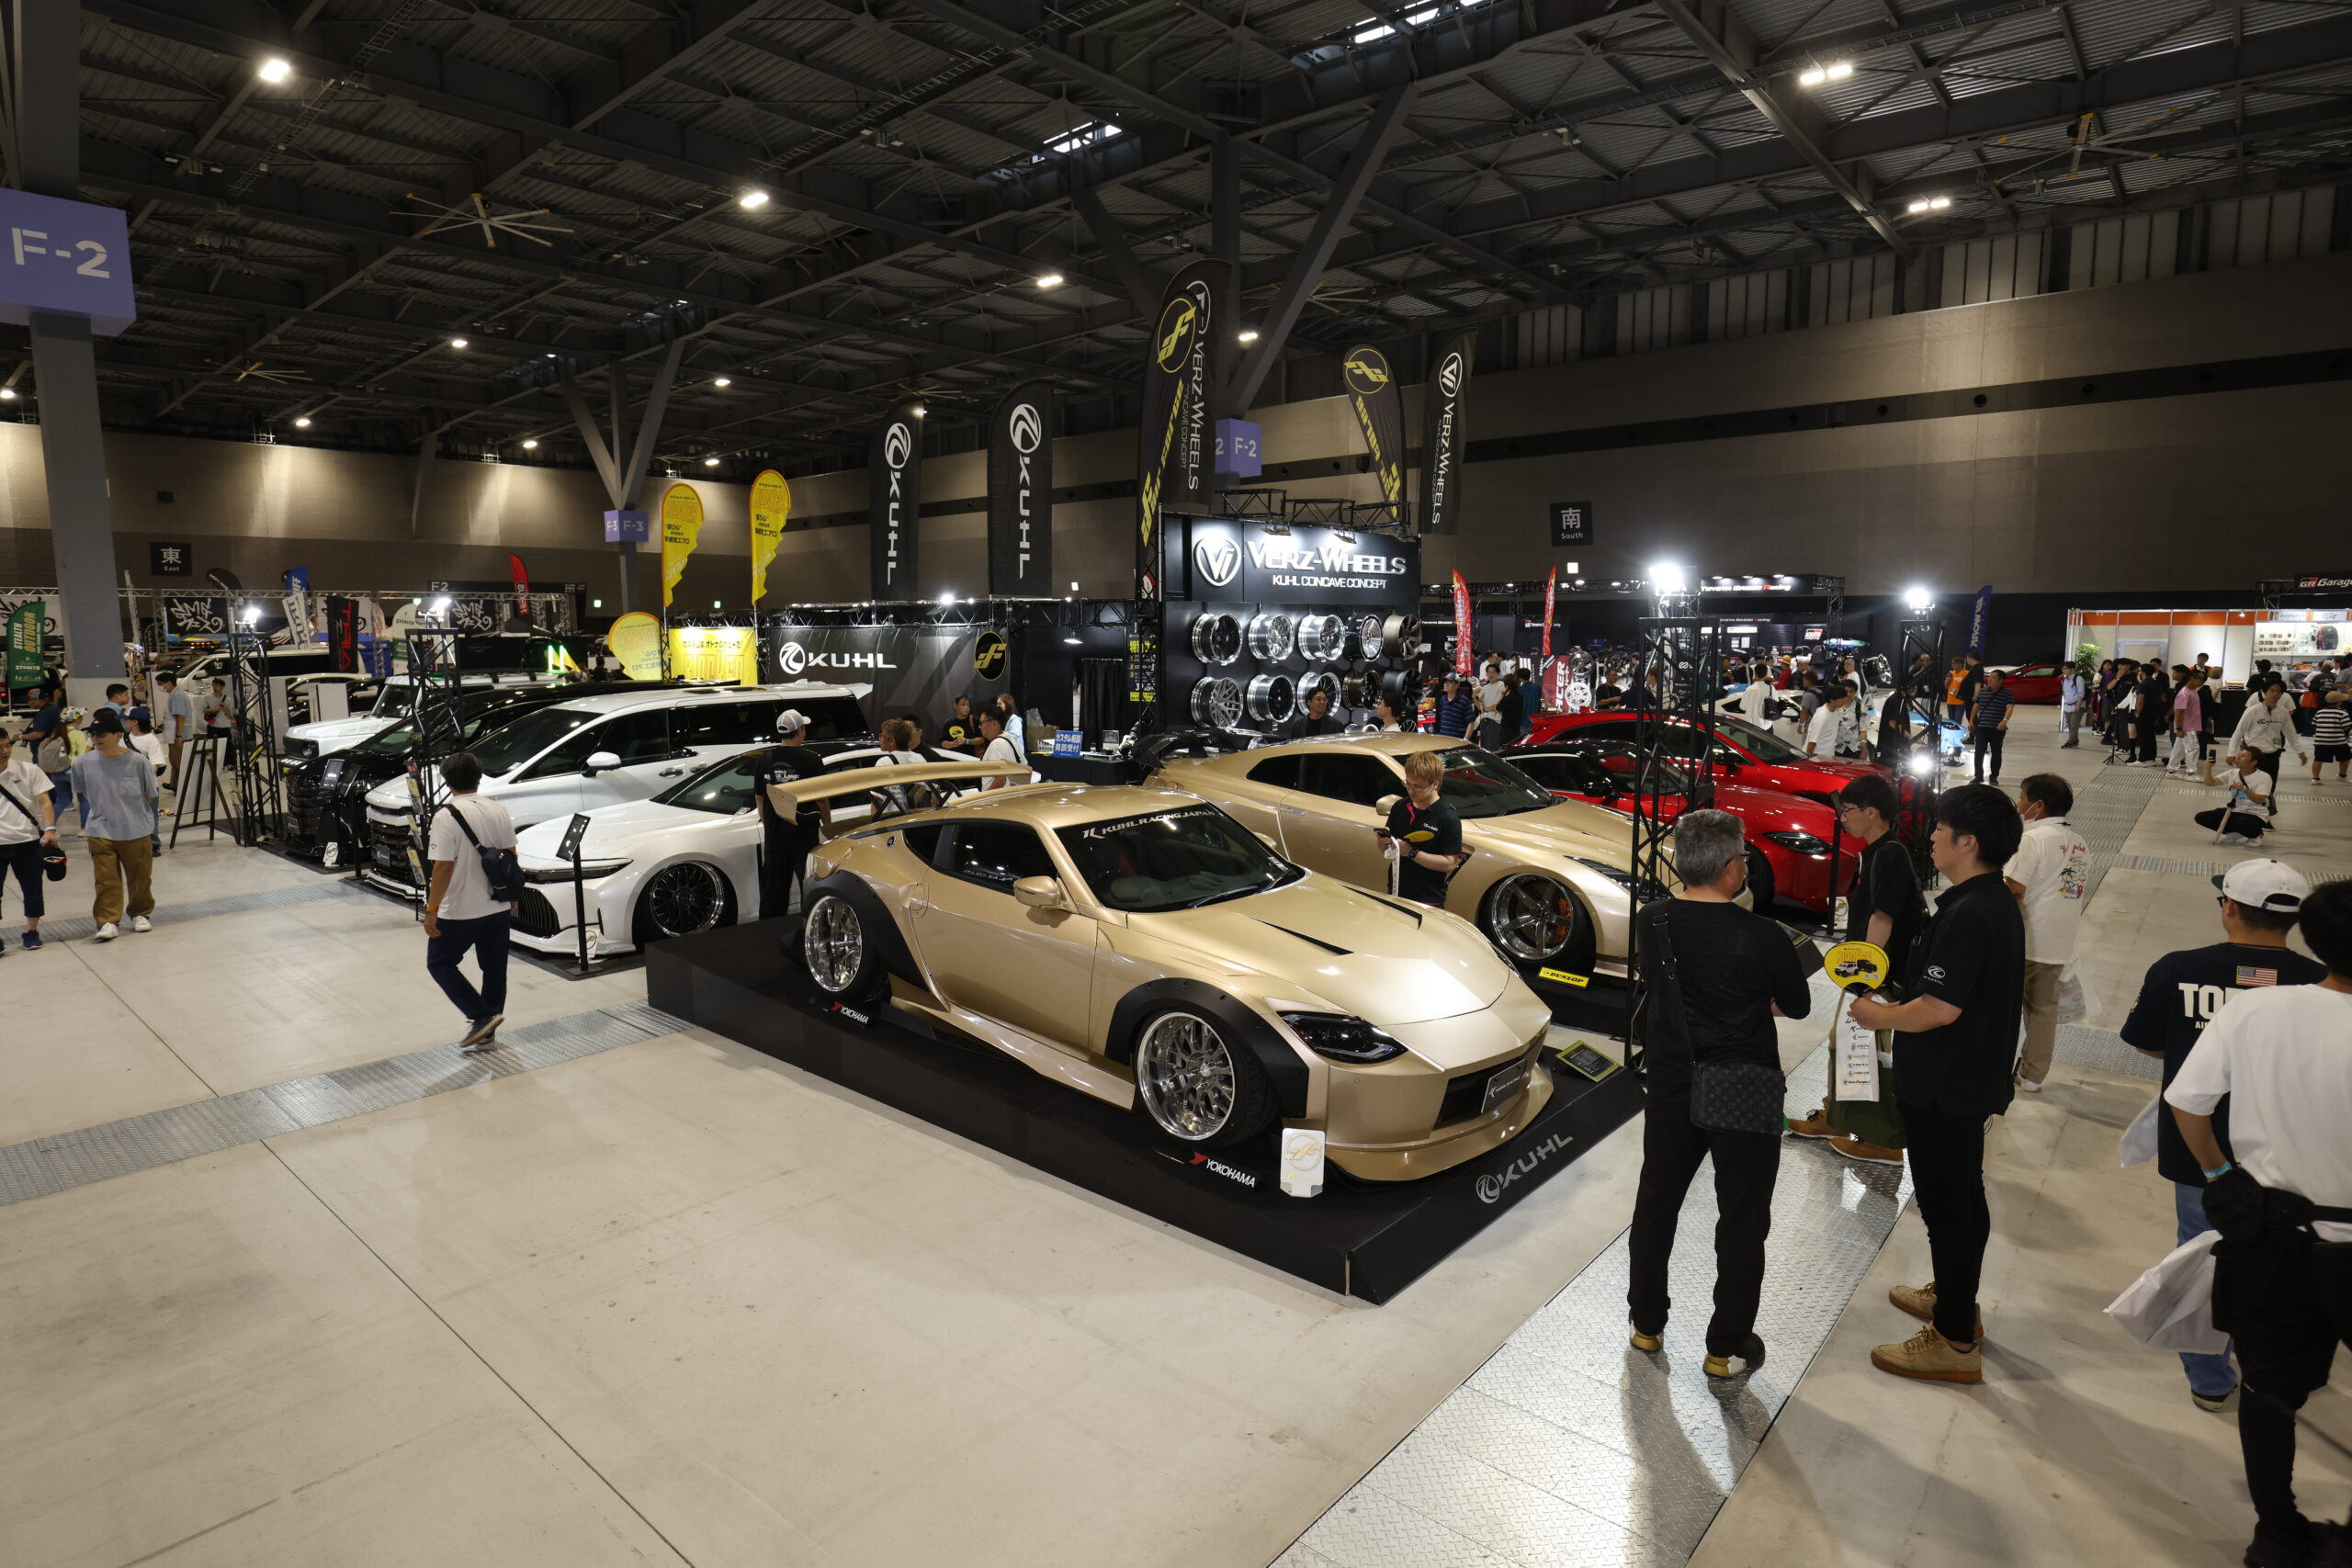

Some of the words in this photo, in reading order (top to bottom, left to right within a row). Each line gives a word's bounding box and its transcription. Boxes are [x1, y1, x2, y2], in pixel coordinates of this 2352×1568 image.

[12, 227, 110, 279] F-2
[1188, 341, 1204, 491] VERZ-WHEELS
[1235, 437, 1256, 457] F-2
[1431, 401, 1455, 524] VERZ-WHEELS
[606, 520, 618, 532] F-3
[623, 520, 644, 532] F-3
[887, 470, 901, 586] KUHL
[1019, 454, 1030, 579] KUHL
[1561, 508, 1581, 530] 南
[161, 547, 182, 564] 東
[1245, 541, 1407, 575] VERZ-WHEELS
[431, 581, 448, 591] F2
[1273, 575, 1300, 587] KUHL
[1301, 576, 1346, 588] CONCAVE
[1346, 578, 1387, 589] CONCEPT
[13, 622, 23, 651] STEALTH
[24, 611, 36, 653] OUTDOOR
[808, 652, 897, 669] KUHL
[1102, 820, 1139, 835] KUHL
[1139, 812, 1182, 825] RACING
[1182, 809, 1215, 818] JAPAN
[1550, 972, 1584, 983] DUNLOP
[840, 1006, 869, 1024] YOKOHAMA
[1205, 1159, 1256, 1188] YOKOHAMA
[1496, 1133, 1573, 1190] KUHL
